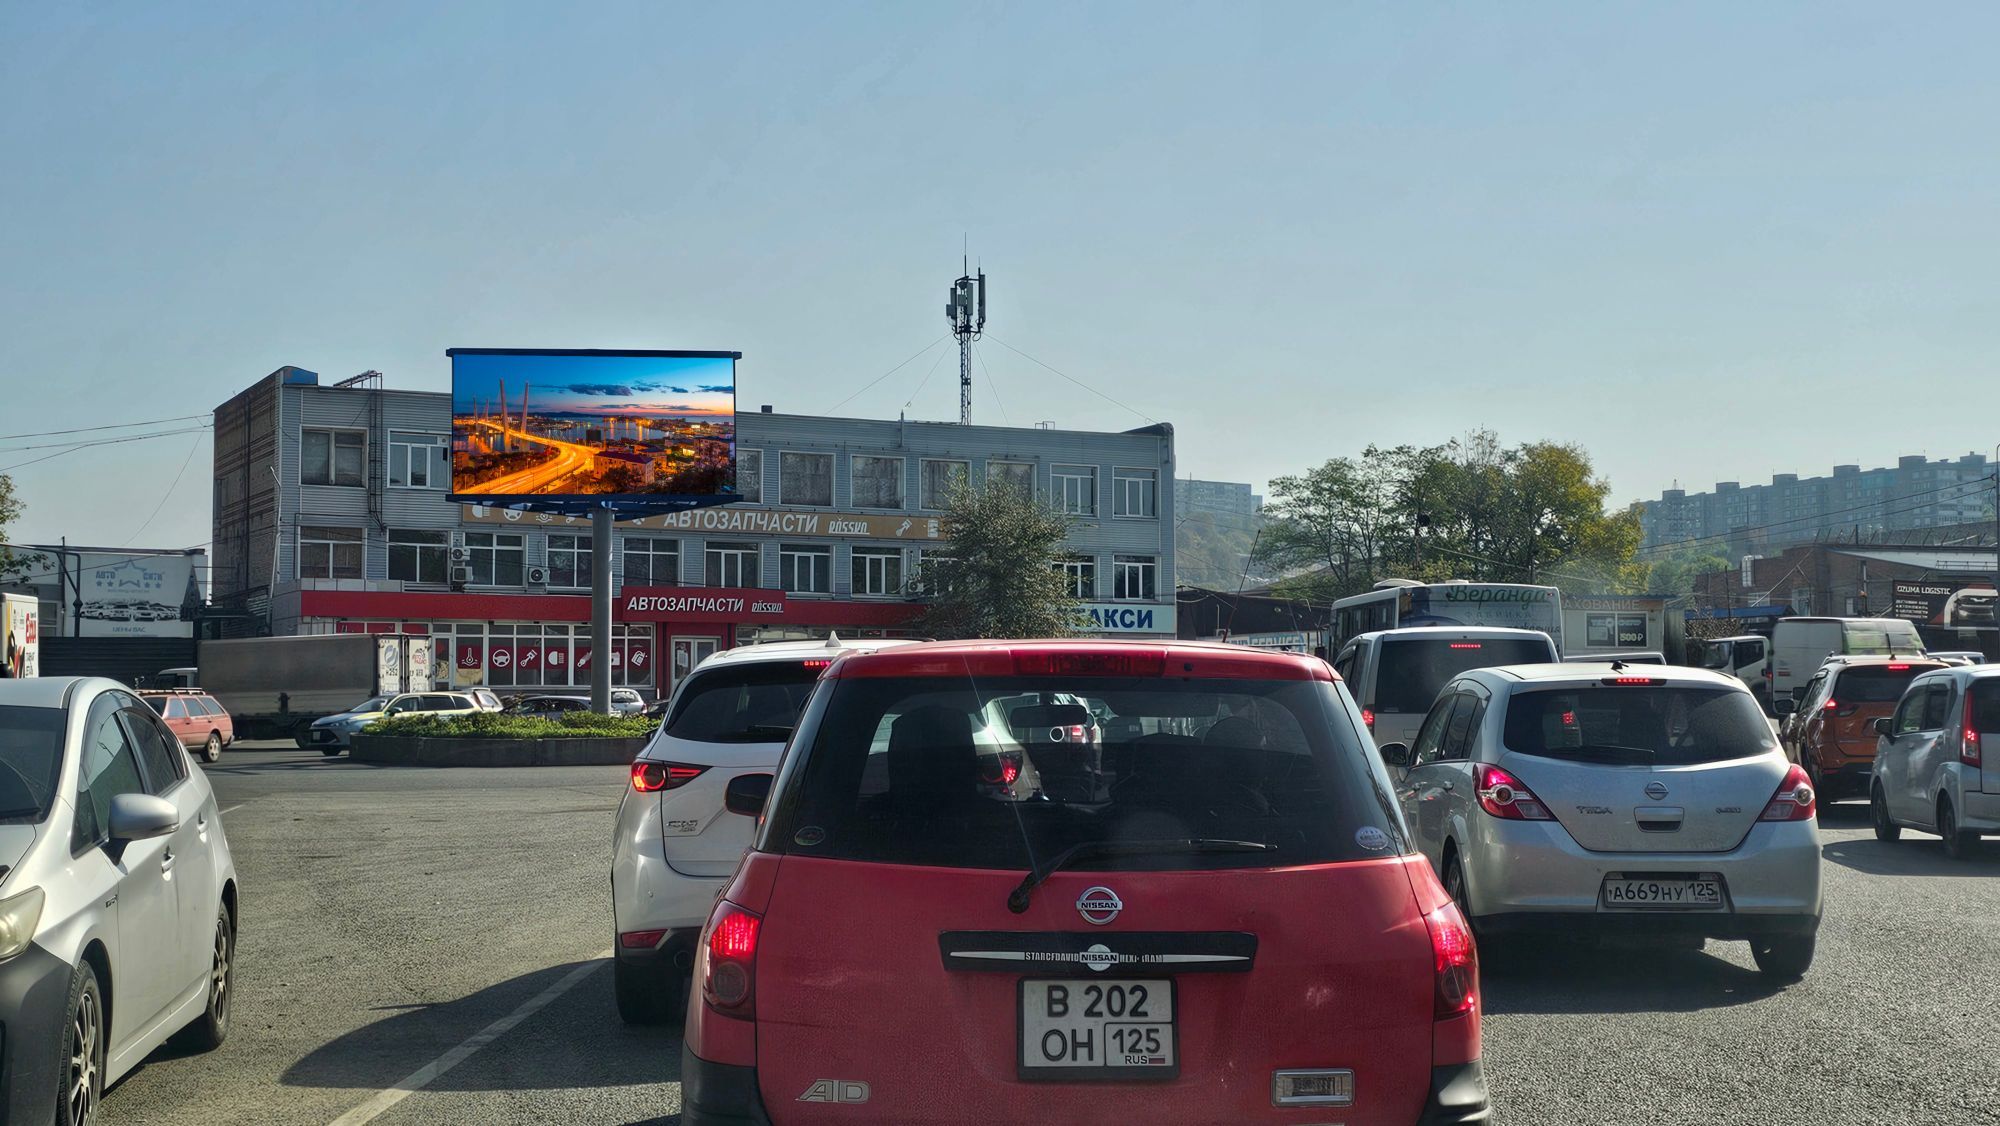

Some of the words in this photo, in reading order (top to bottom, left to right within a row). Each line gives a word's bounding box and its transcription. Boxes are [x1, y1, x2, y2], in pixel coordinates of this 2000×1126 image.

[664, 510, 819, 533] АВТОЗАПЧАСТИ
[627, 596, 745, 613] АВТОЗАПЧАСТИ
[1446, 585, 1546, 610] Веранда
[1562, 600, 1641, 610] АХОВАНИЕ
[1613, 883, 1683, 900] А669НУ
[1688, 883, 1715, 897] 125
[1080, 901, 1119, 909] NISSAN
[1081, 953, 1118, 962] NISSAN
[1047, 984, 1069, 1018] В
[1083, 984, 1149, 1018] 202
[1041, 1028, 1094, 1062] ОН
[1112, 1028, 1161, 1055] 125
[1124, 1055, 1148, 1065] RUS
